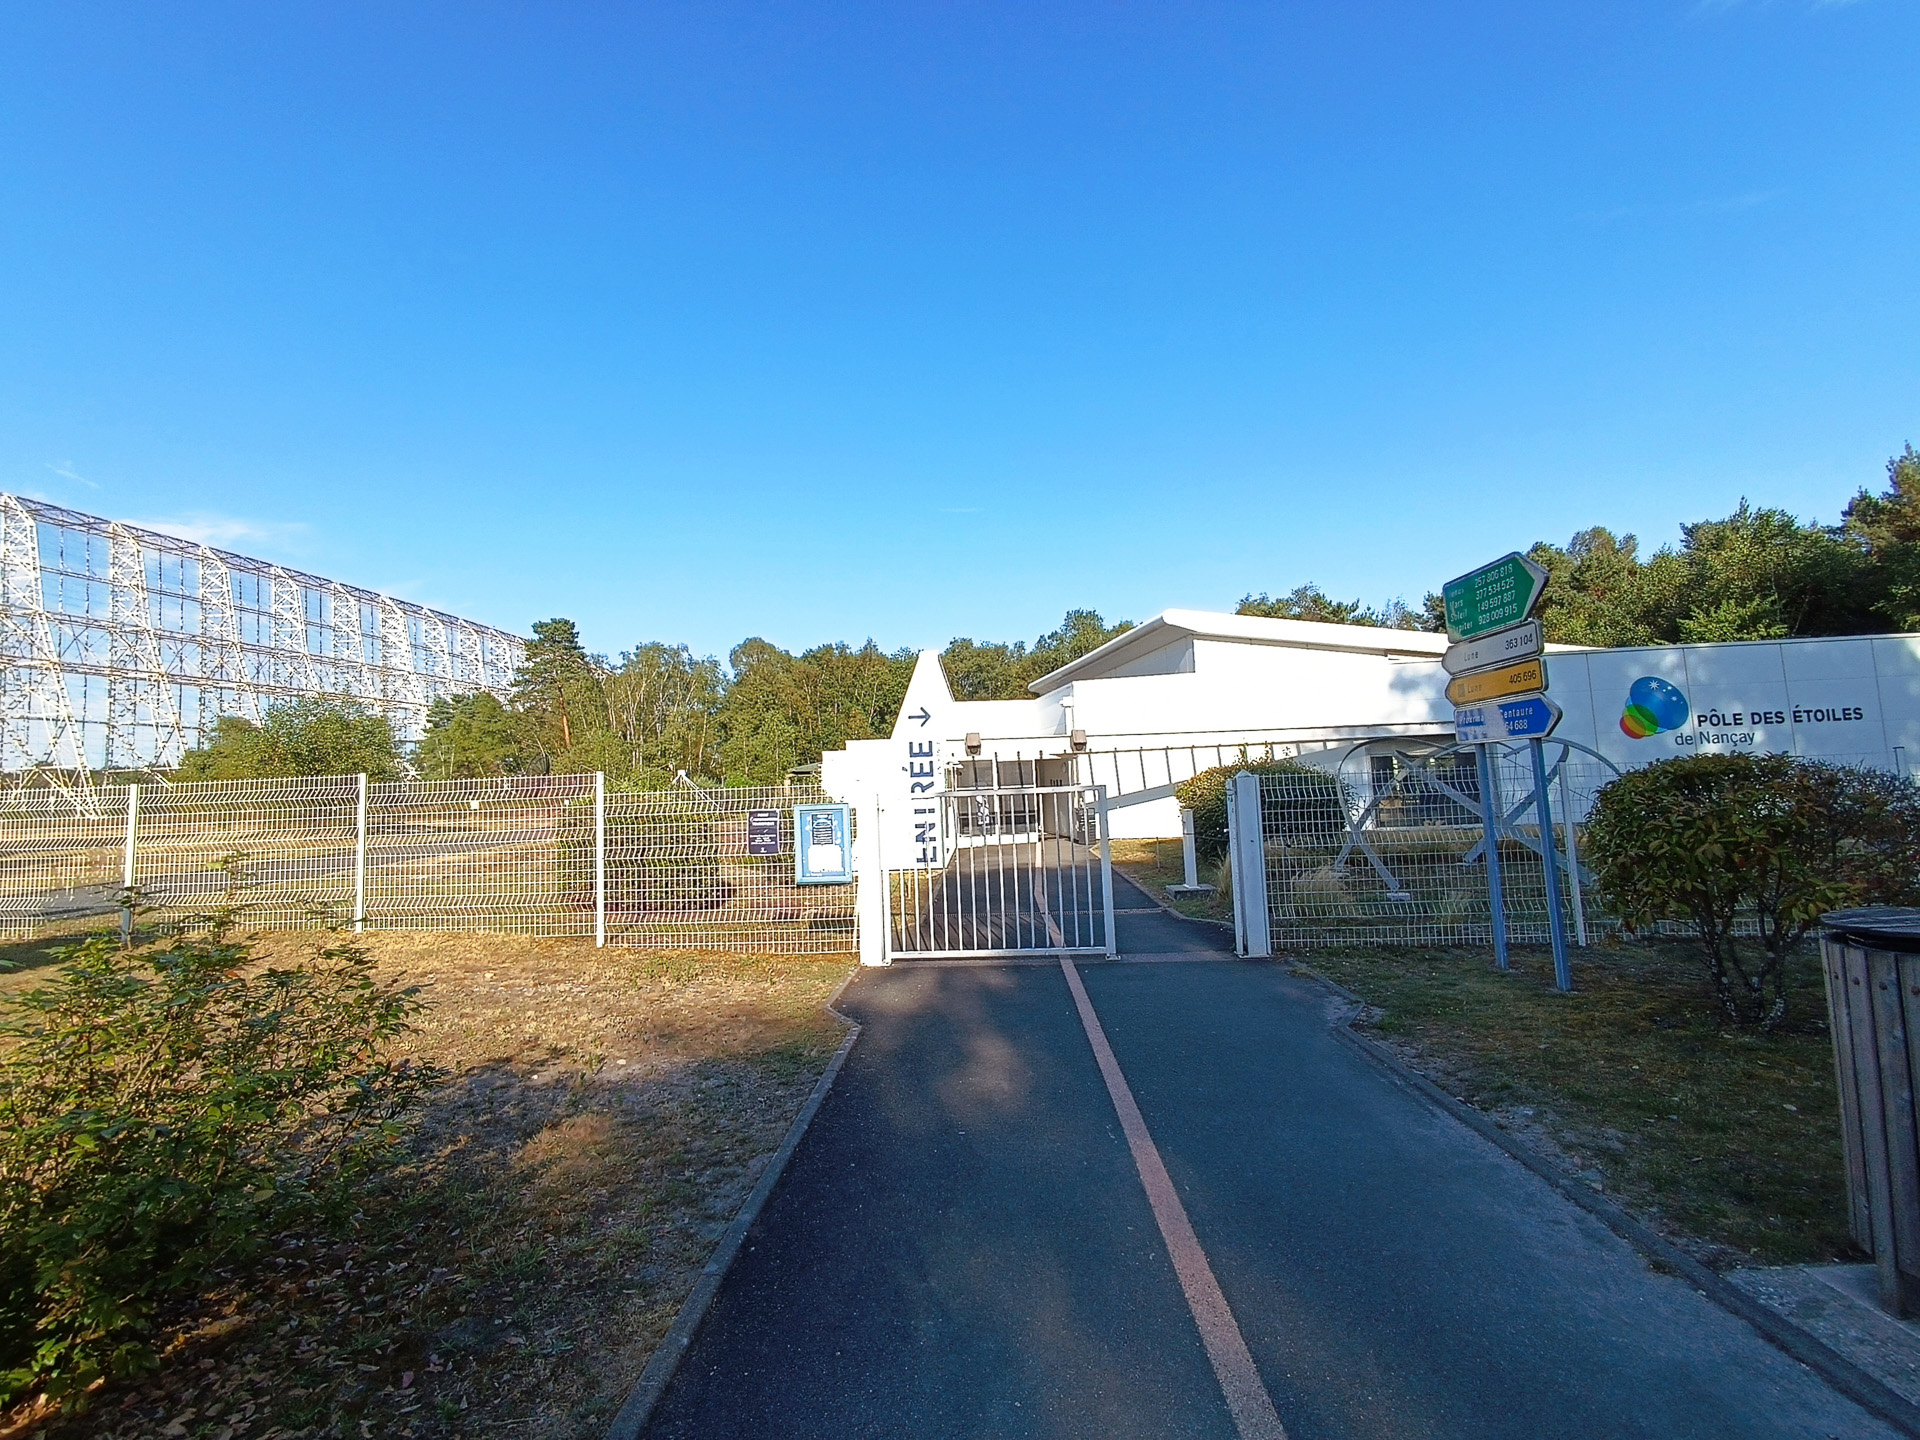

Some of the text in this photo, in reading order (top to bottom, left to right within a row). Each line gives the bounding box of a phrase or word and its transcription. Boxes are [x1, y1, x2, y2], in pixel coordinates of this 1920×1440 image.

[1476, 588, 1487, 600] 377
[1478, 600, 1489, 612] 149
[1490, 595, 1501, 608] 597
[1491, 608, 1504, 620] 009
[1505, 603, 1517, 616] 915
[1520, 633, 1533, 646] 104
[1509, 673, 1521, 684] 405
[1523, 670, 1536, 681] 696
[1697, 704, 1864, 727] PÔLE DES ÉTOILES
[1674, 731, 1755, 747] de Nançay
